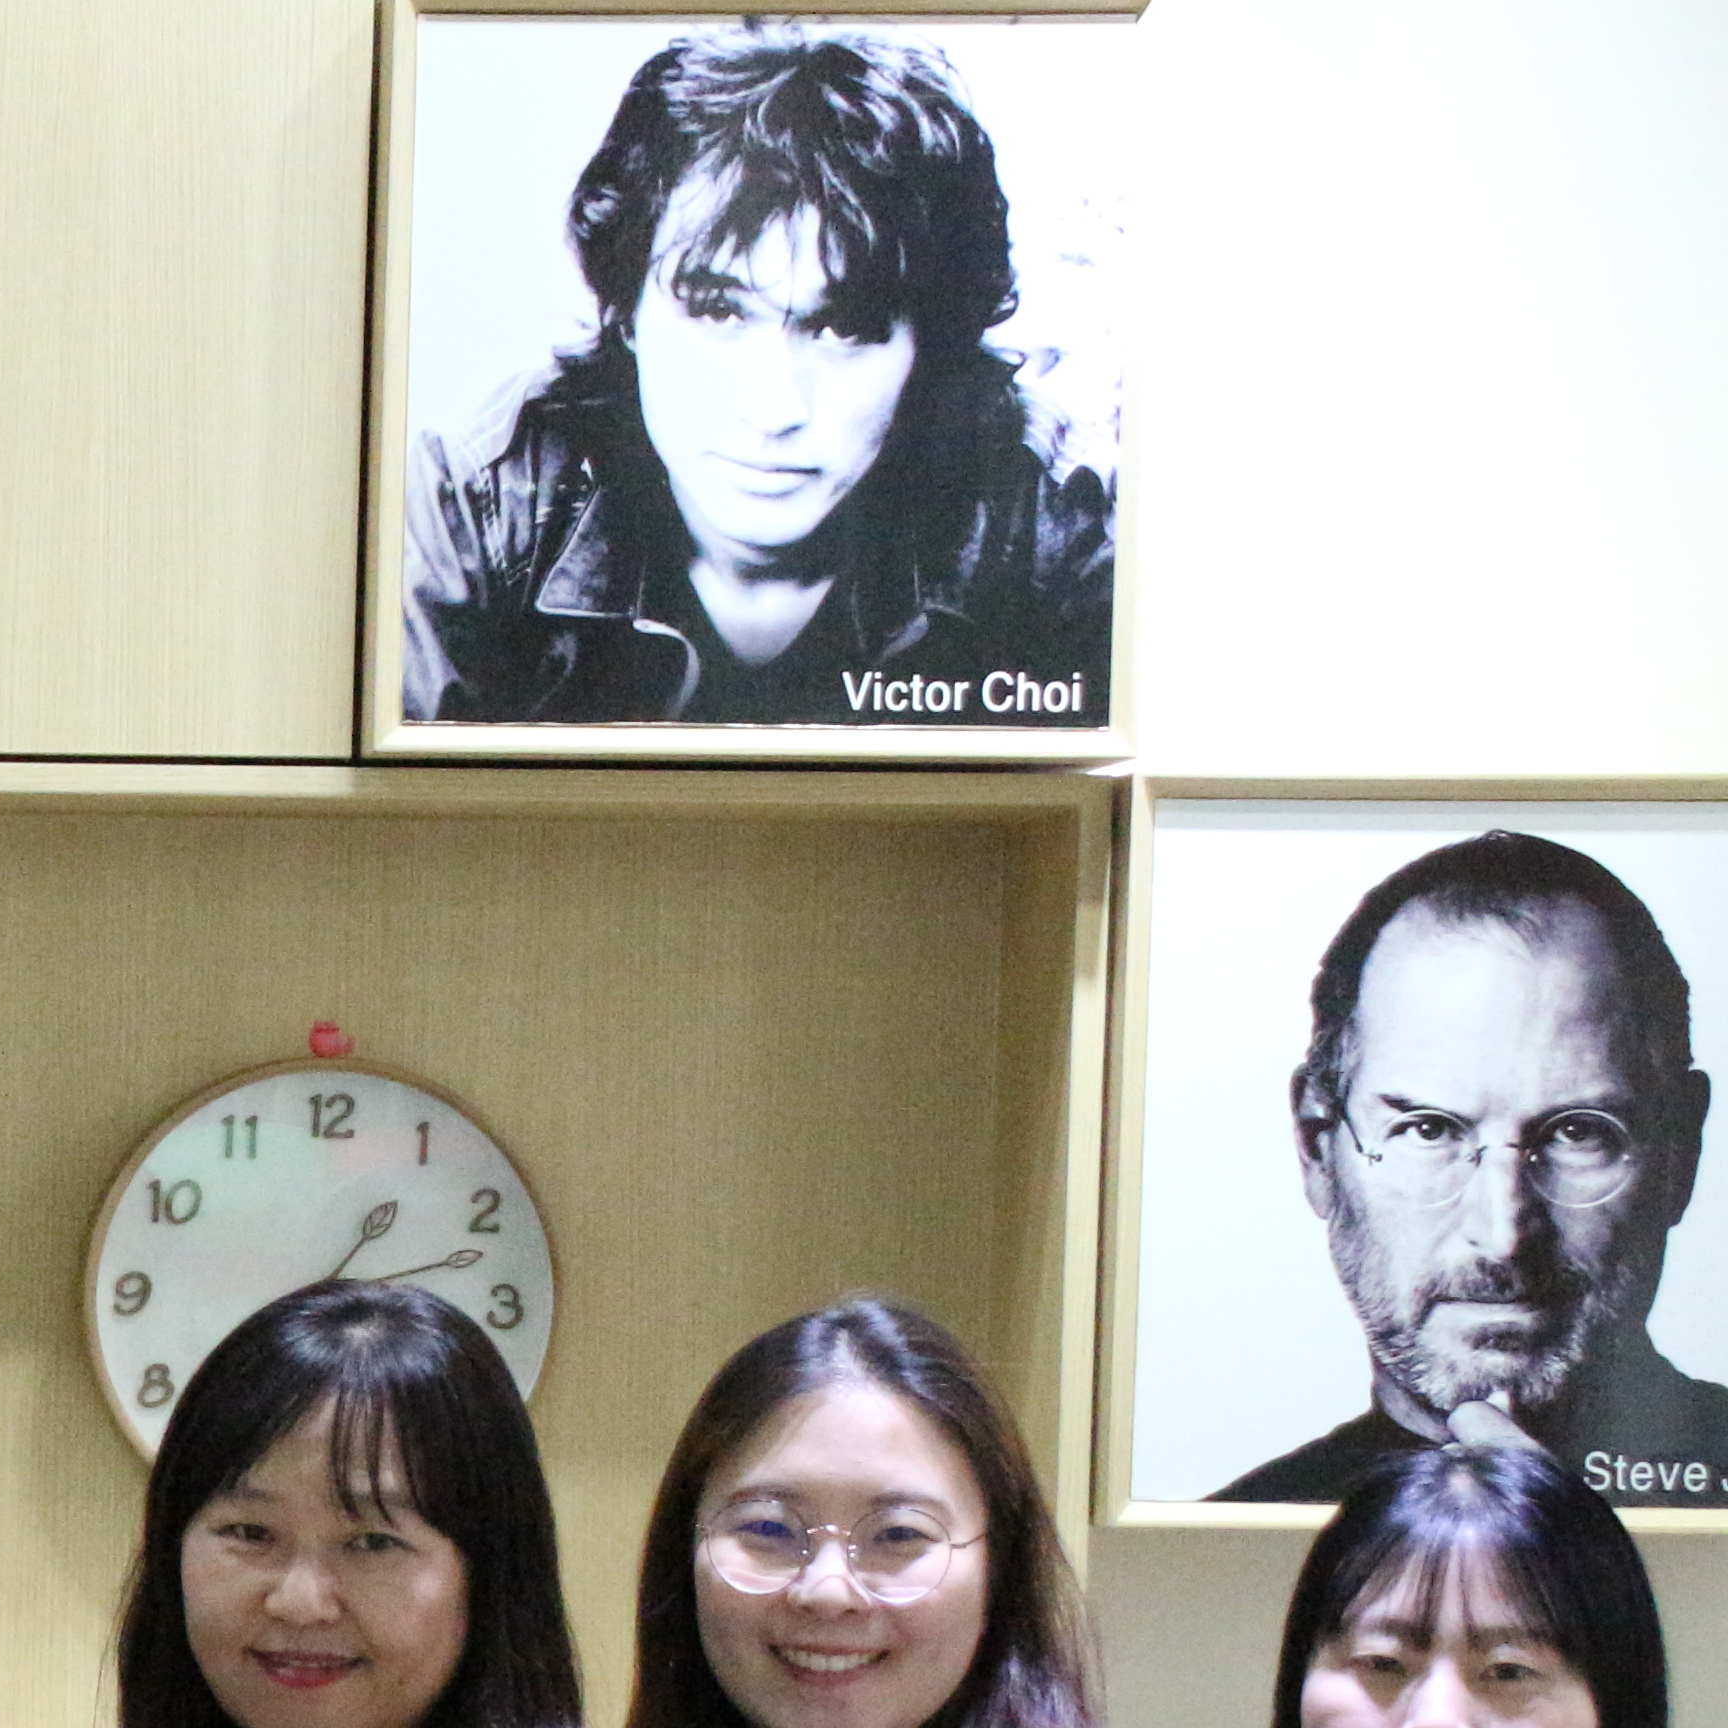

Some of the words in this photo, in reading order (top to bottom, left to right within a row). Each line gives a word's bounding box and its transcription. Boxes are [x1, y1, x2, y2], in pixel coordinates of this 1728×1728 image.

[842, 671, 970, 712] Victor
[982, 670, 1082, 713] Choi
[221, 1114, 258, 1159] 11
[309, 1093, 355, 1139] 12
[415, 1121, 431, 1166] 1
[147, 1179, 202, 1226] 10
[468, 1188, 503, 1235] 2
[112, 1271, 152, 1316] 9
[486, 1283, 524, 1329] 3
[136, 1363, 175, 1409] 8
[1583, 1450, 1708, 1492] Steve
